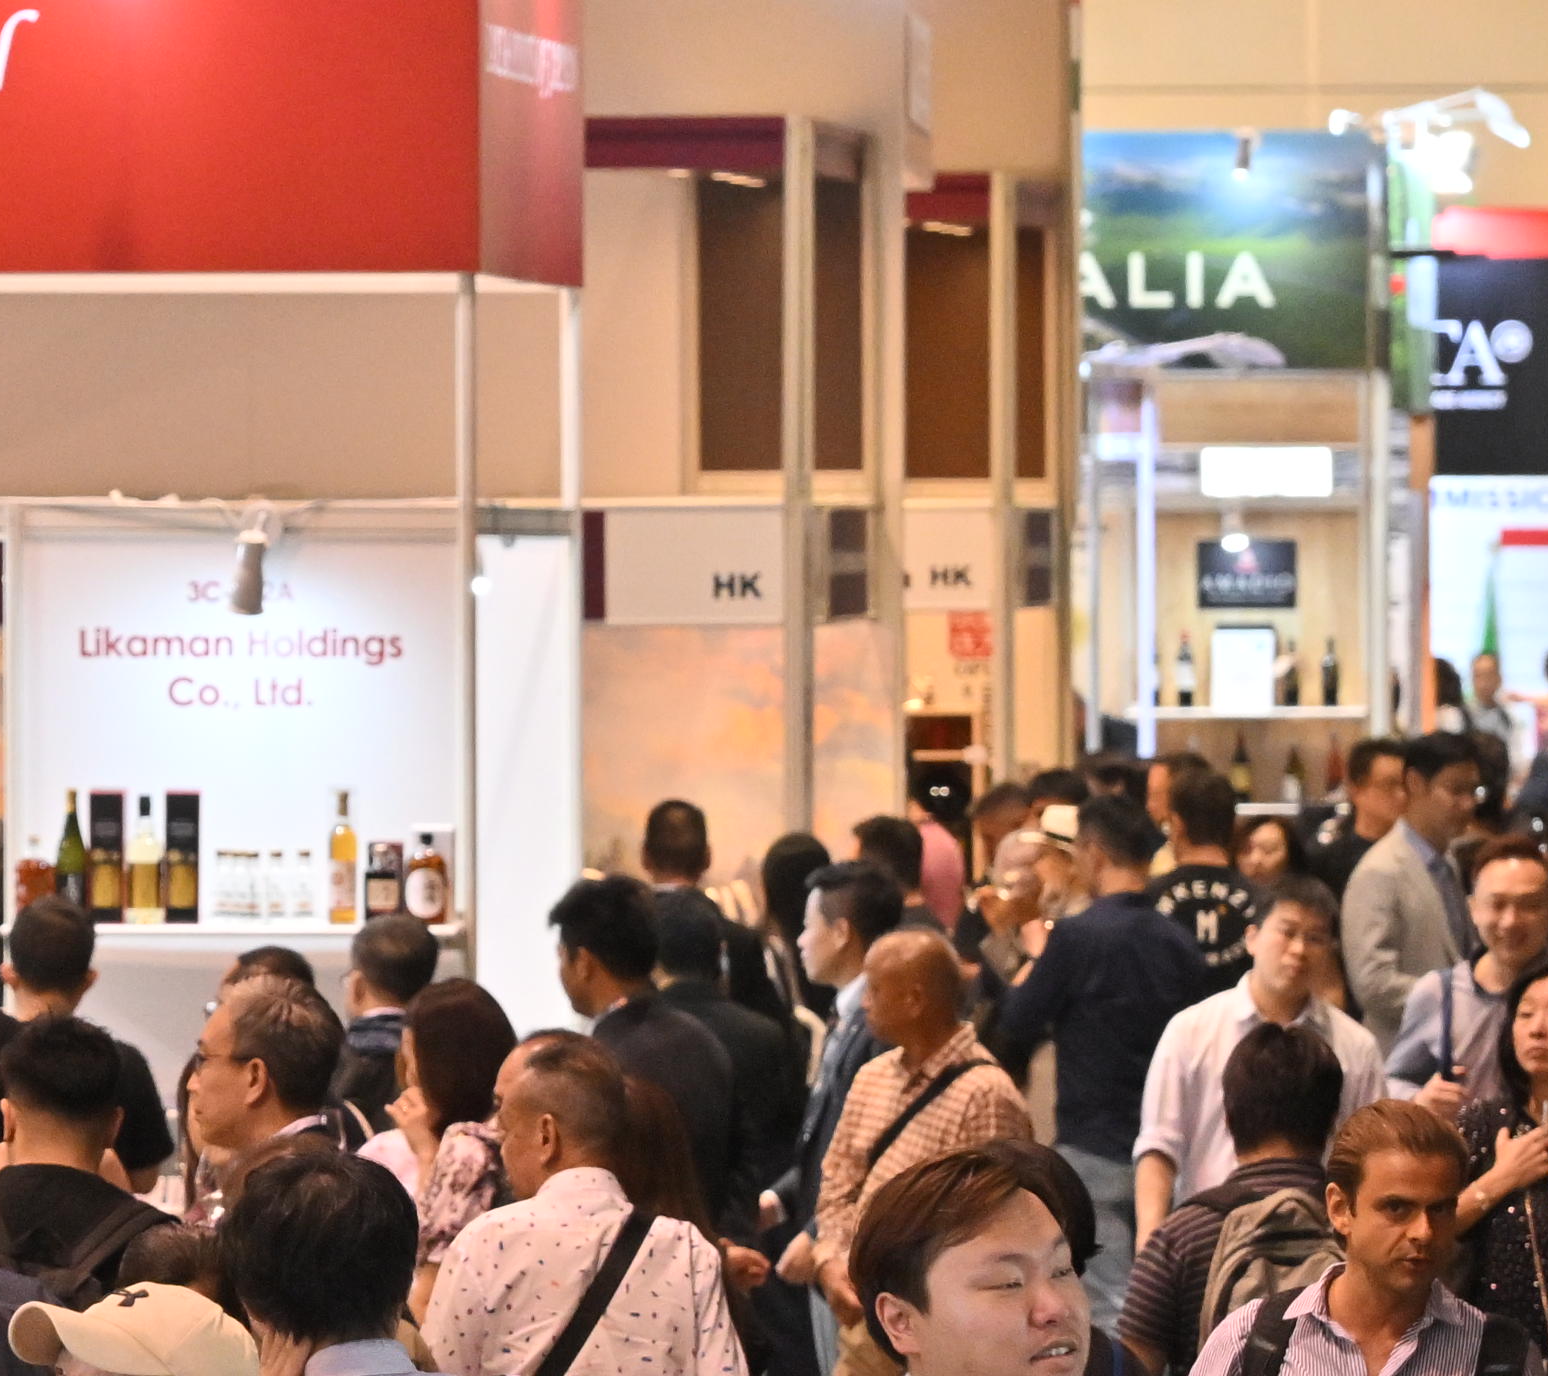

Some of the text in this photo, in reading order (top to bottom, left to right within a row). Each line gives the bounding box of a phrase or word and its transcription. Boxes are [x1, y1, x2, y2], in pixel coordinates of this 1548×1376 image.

[712, 572, 762, 601] HK
[929, 564, 973, 588] HK
[78, 628, 404, 668] Likaman Holdings
[167, 676, 314, 710] Co., Ltd.
